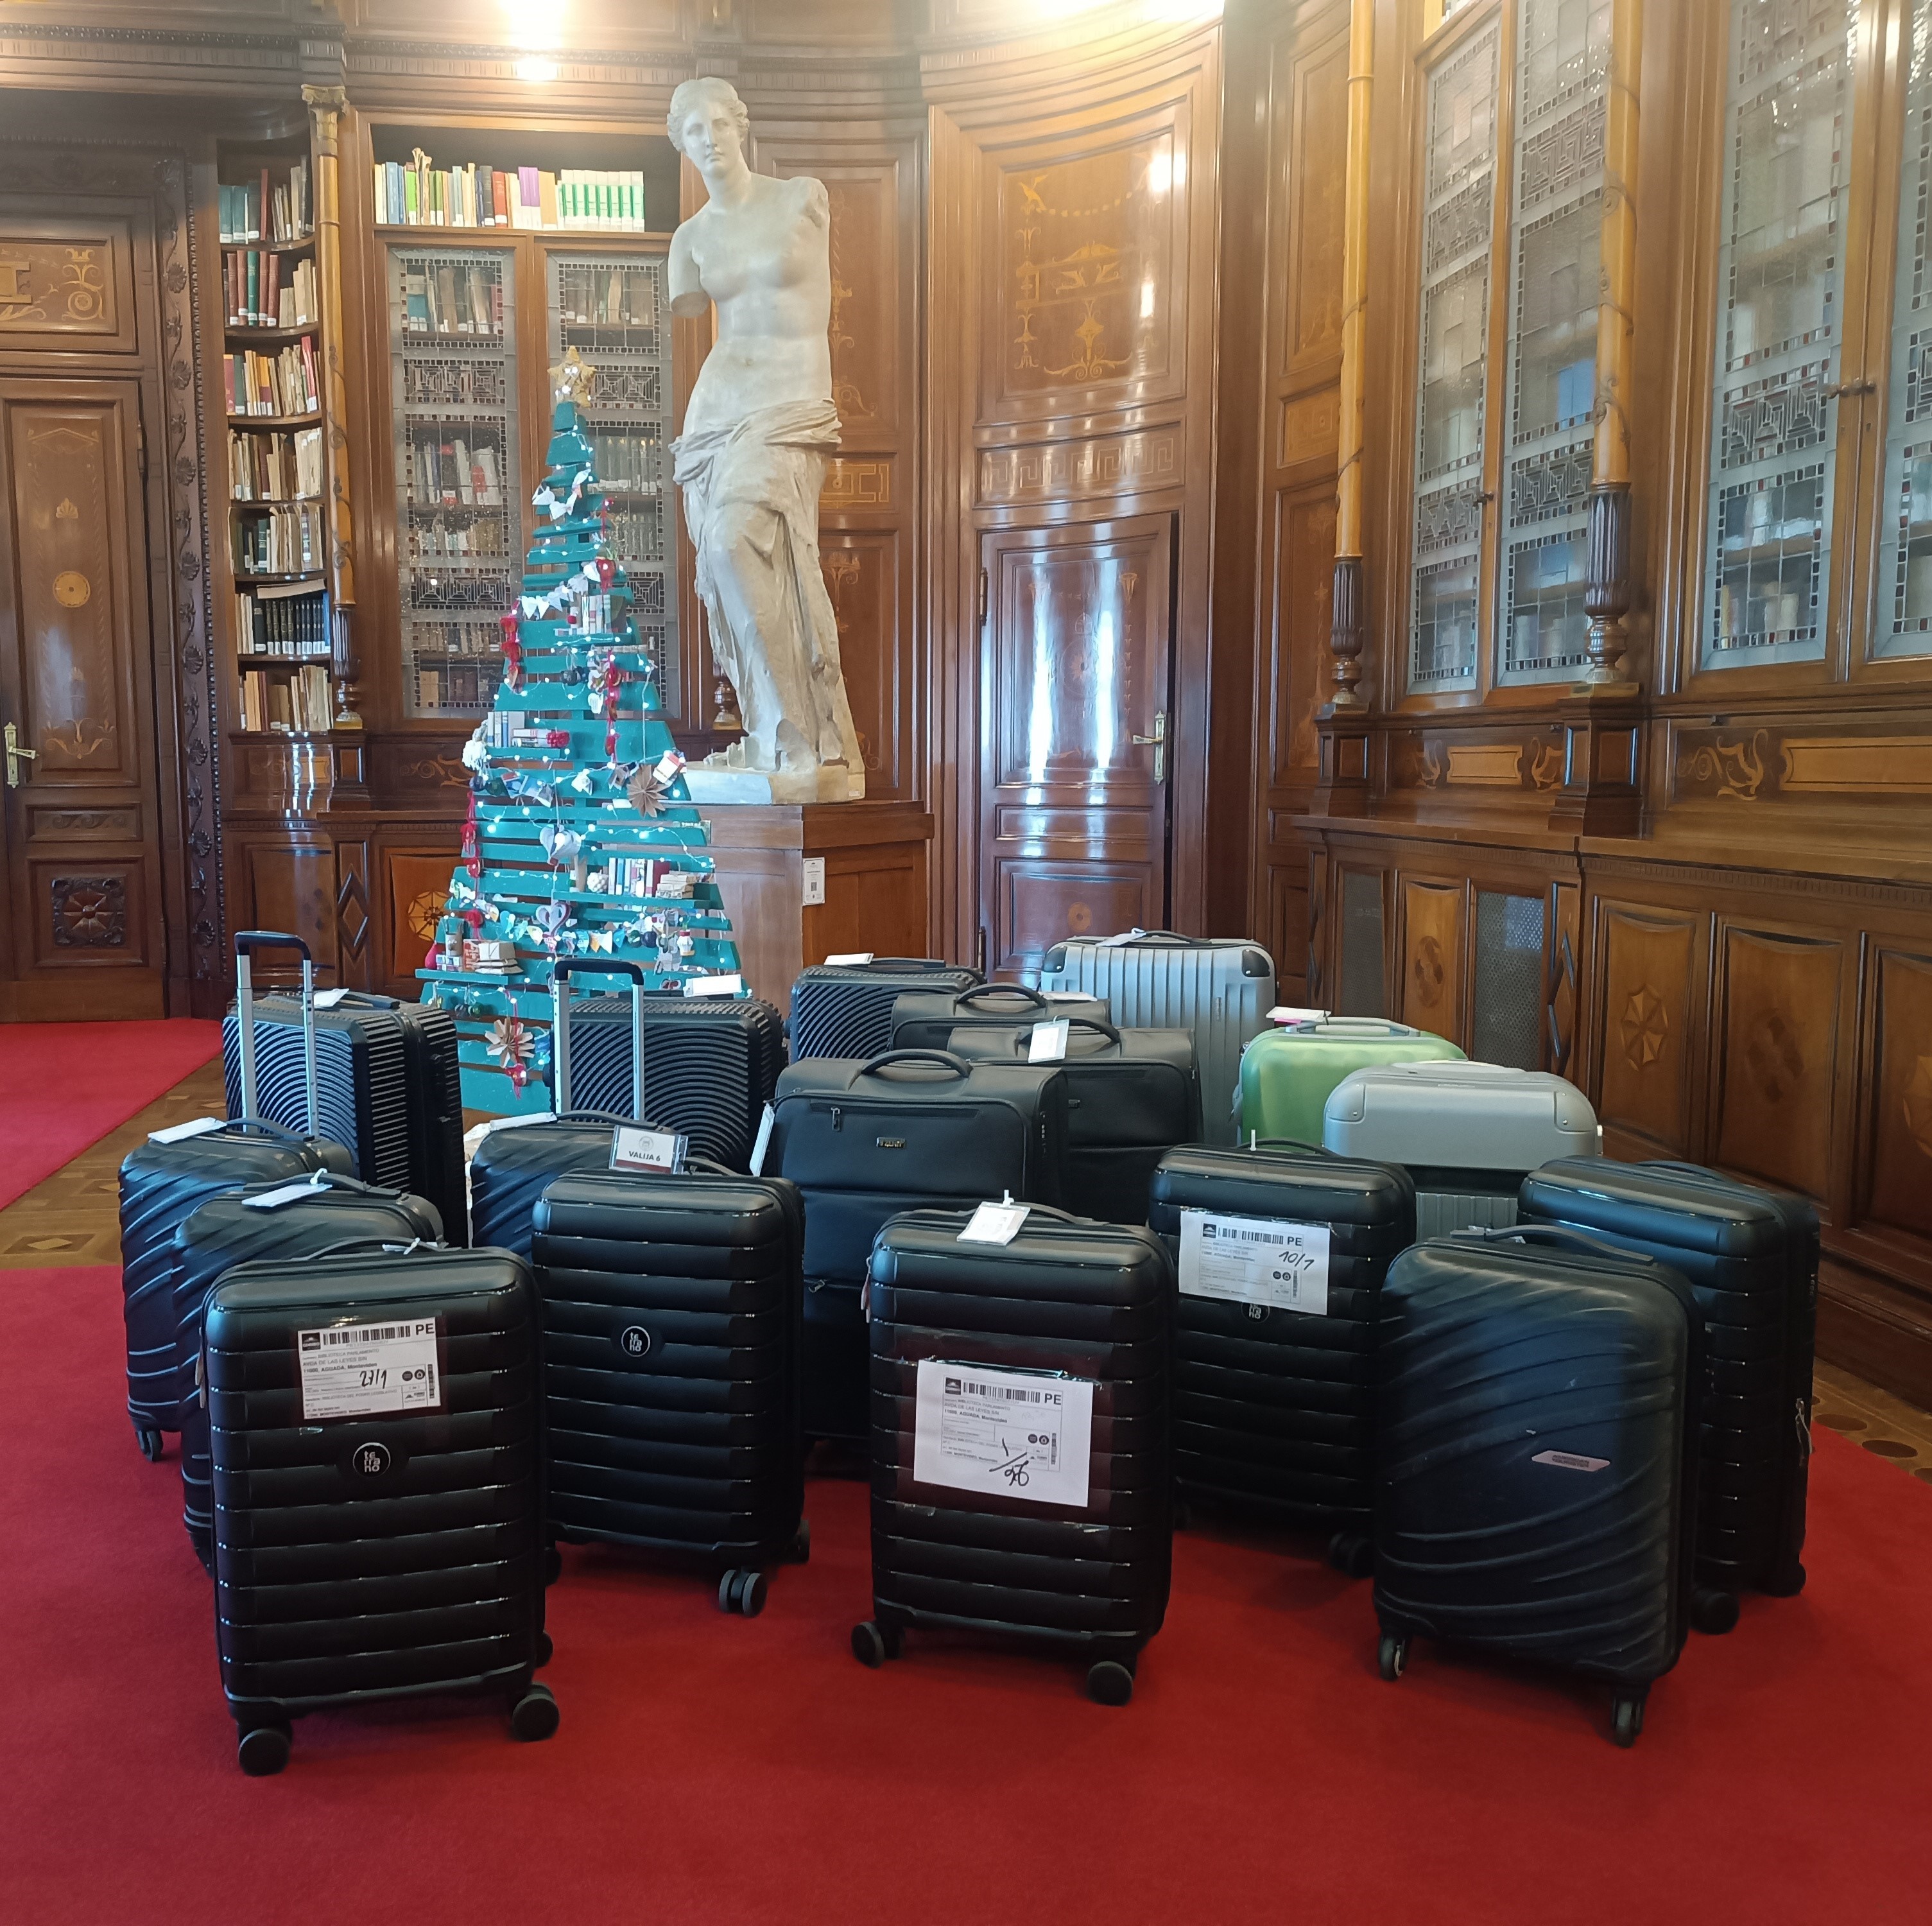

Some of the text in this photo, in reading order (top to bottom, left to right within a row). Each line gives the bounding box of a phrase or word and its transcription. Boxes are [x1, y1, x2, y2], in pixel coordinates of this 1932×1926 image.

[629, 1150, 654, 1160] VALIJA
[1287, 1236, 1302, 1246] PE
[415, 1323, 435, 1335] PE
[1045, 1392, 1062, 1405] PE
